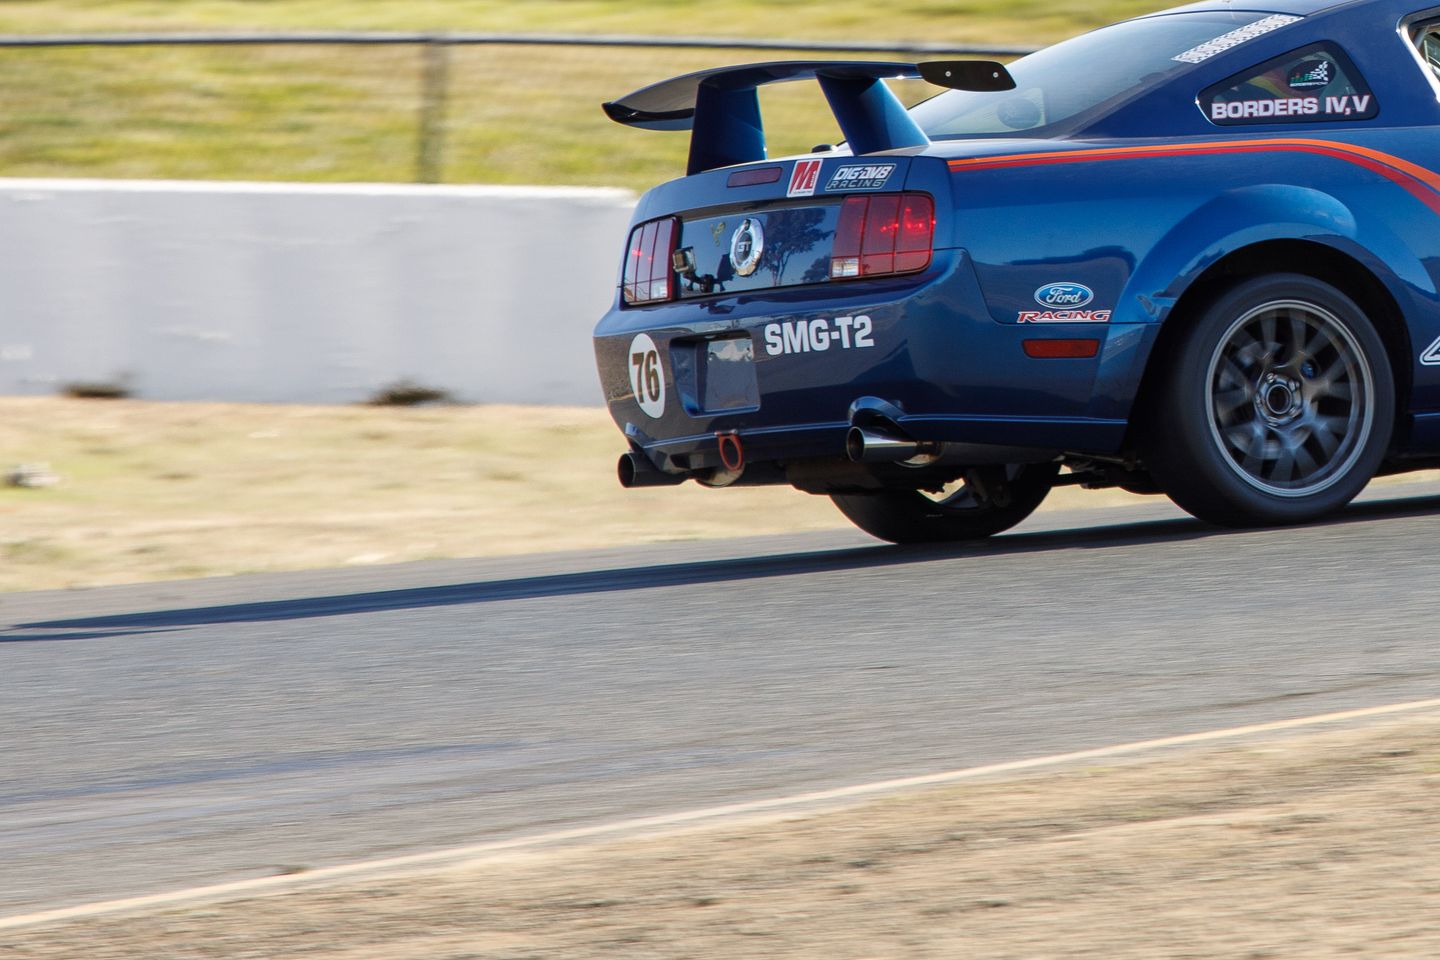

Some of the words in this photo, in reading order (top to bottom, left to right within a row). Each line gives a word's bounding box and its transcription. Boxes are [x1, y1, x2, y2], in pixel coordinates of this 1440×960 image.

[1211, 97, 1319, 119] BORDERS
[1325, 95, 1370, 116] IV,V
[829, 179, 882, 189] RACING
[736, 242, 752, 253] GT
[1046, 287, 1082, 303] Ford
[1016, 309, 1112, 324] RACING
[764, 315, 875, 356] SMG-T2
[632, 349, 660, 404] 76
